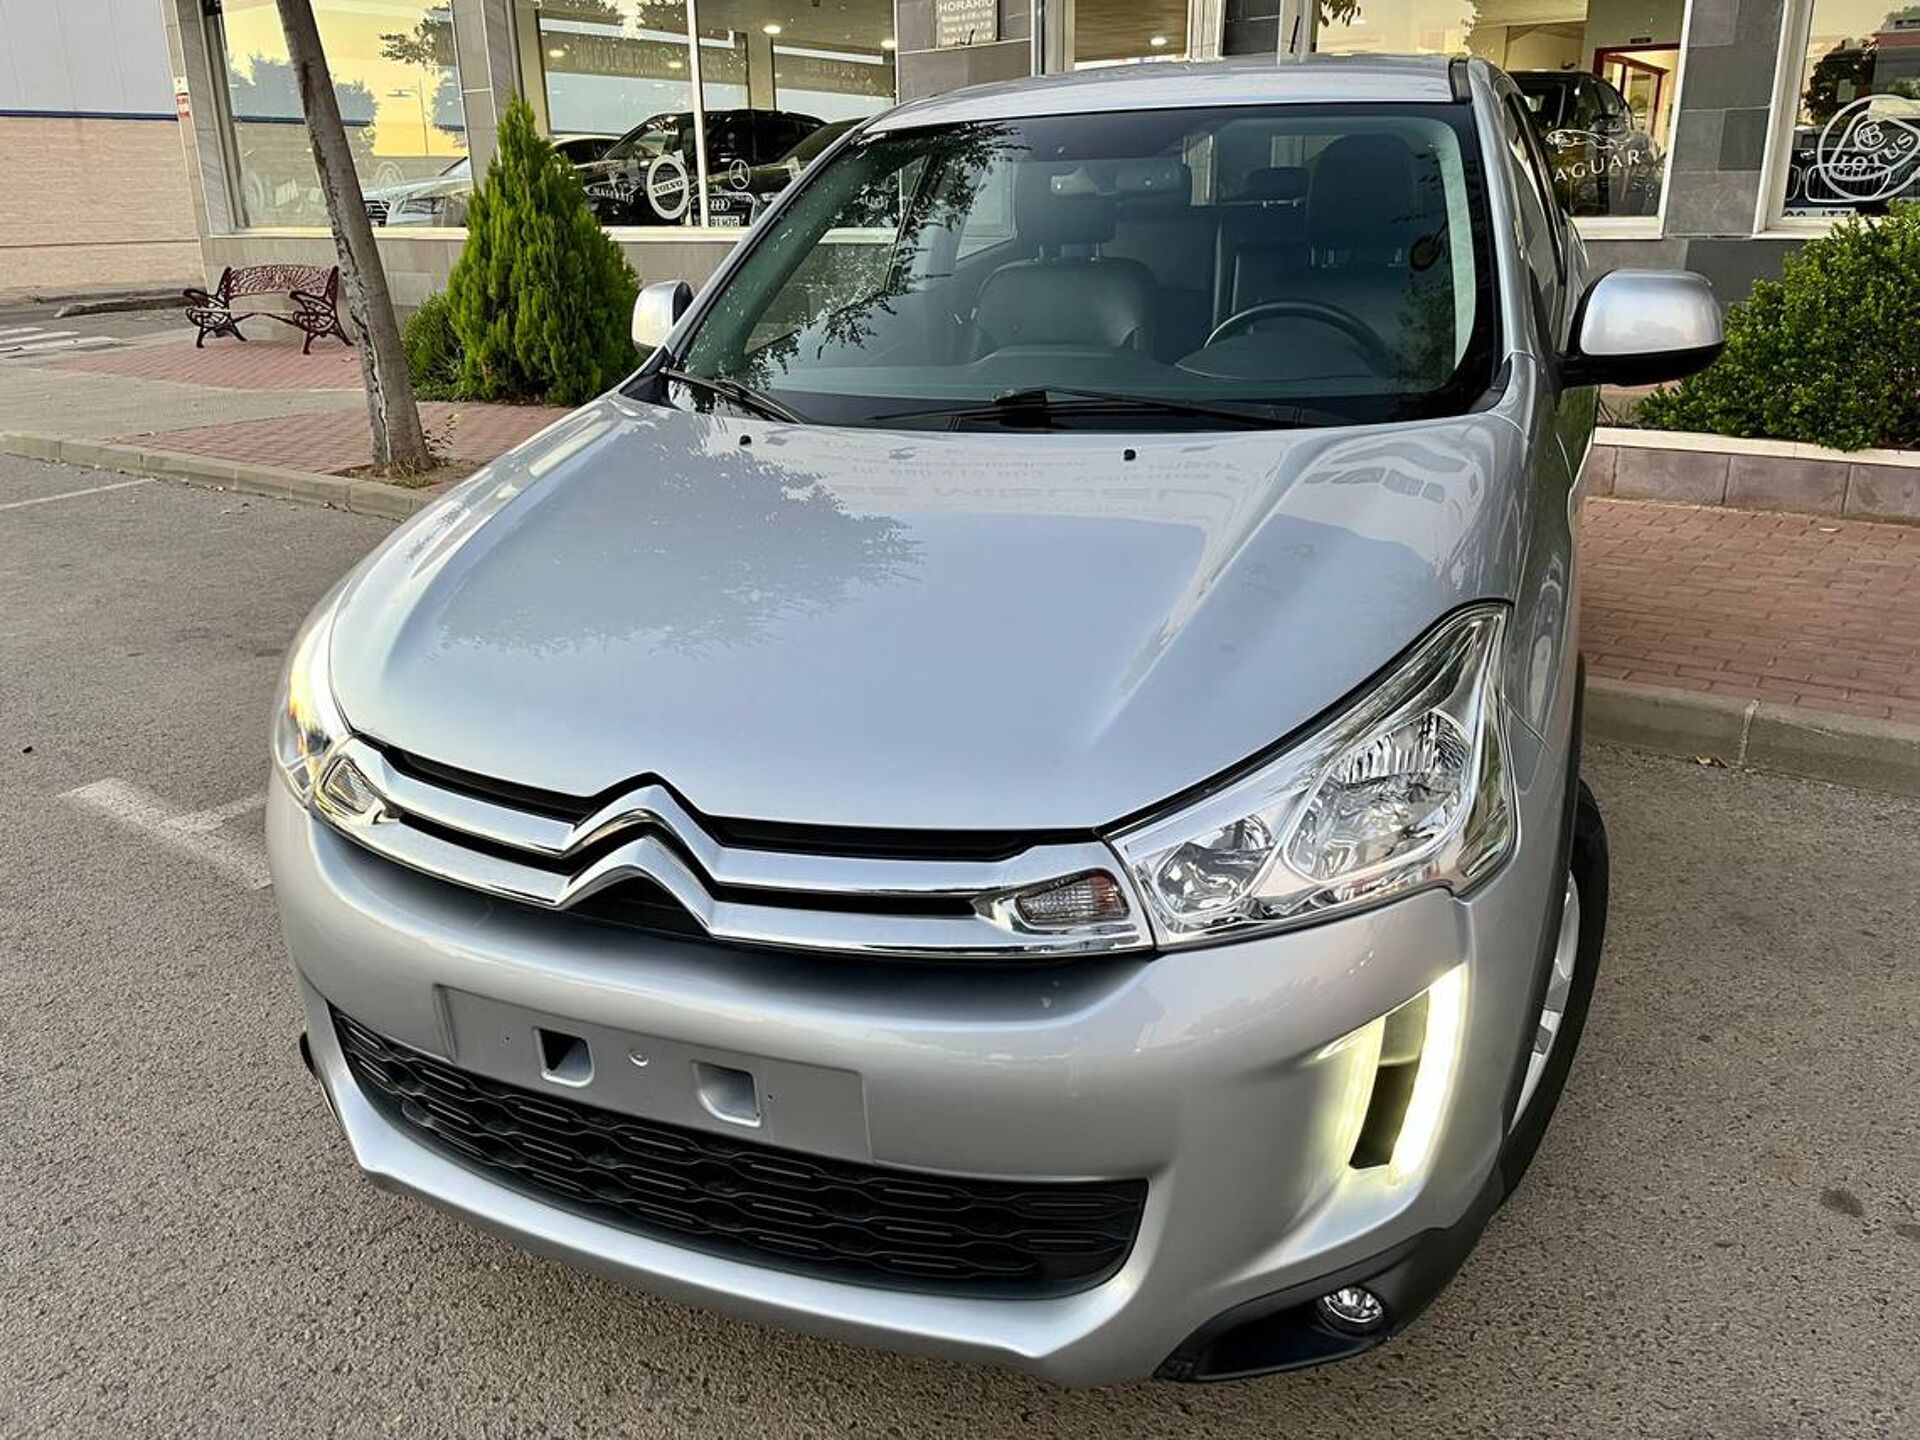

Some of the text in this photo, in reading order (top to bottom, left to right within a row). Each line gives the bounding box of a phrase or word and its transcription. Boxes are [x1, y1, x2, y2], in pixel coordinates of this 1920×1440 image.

[1554, 149, 1641, 183] AGUAR
[1838, 131, 1914, 171] LOTUS
[652, 180, 682, 194] VOLVO
